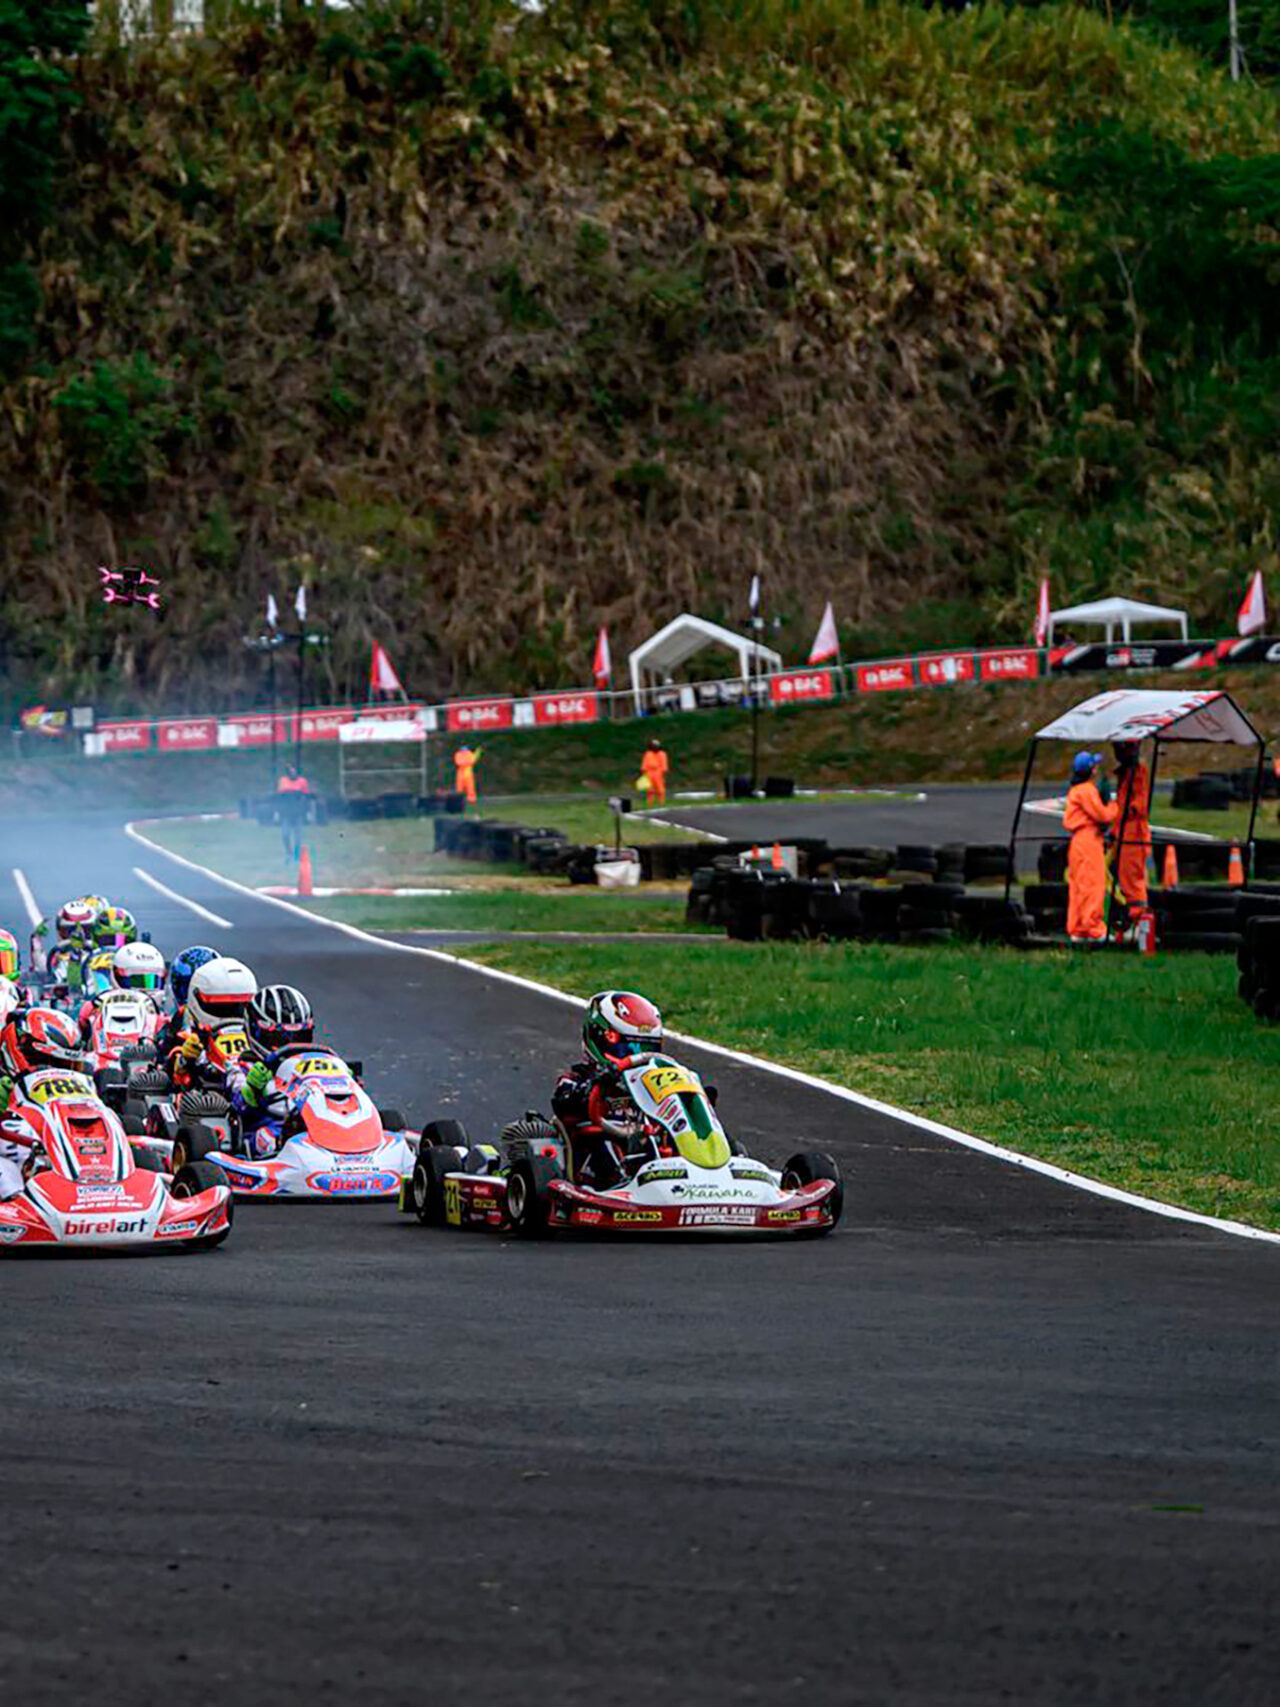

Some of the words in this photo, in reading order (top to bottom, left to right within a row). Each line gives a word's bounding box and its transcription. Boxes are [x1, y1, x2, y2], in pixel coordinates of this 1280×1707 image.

[1003, 656, 1028, 671] BAC
[879, 667, 904, 682] BAC
[794, 676, 820, 691] BAC
[474, 706, 499, 720] BAC
[560, 699, 585, 713] BAC
[116, 727, 141, 741] BAC
[181, 726, 207, 739] BAC
[681, 1207, 729, 1217] FORMULA
[730, 1206, 757, 1216] KART
[64, 1218, 148, 1236] birelart
